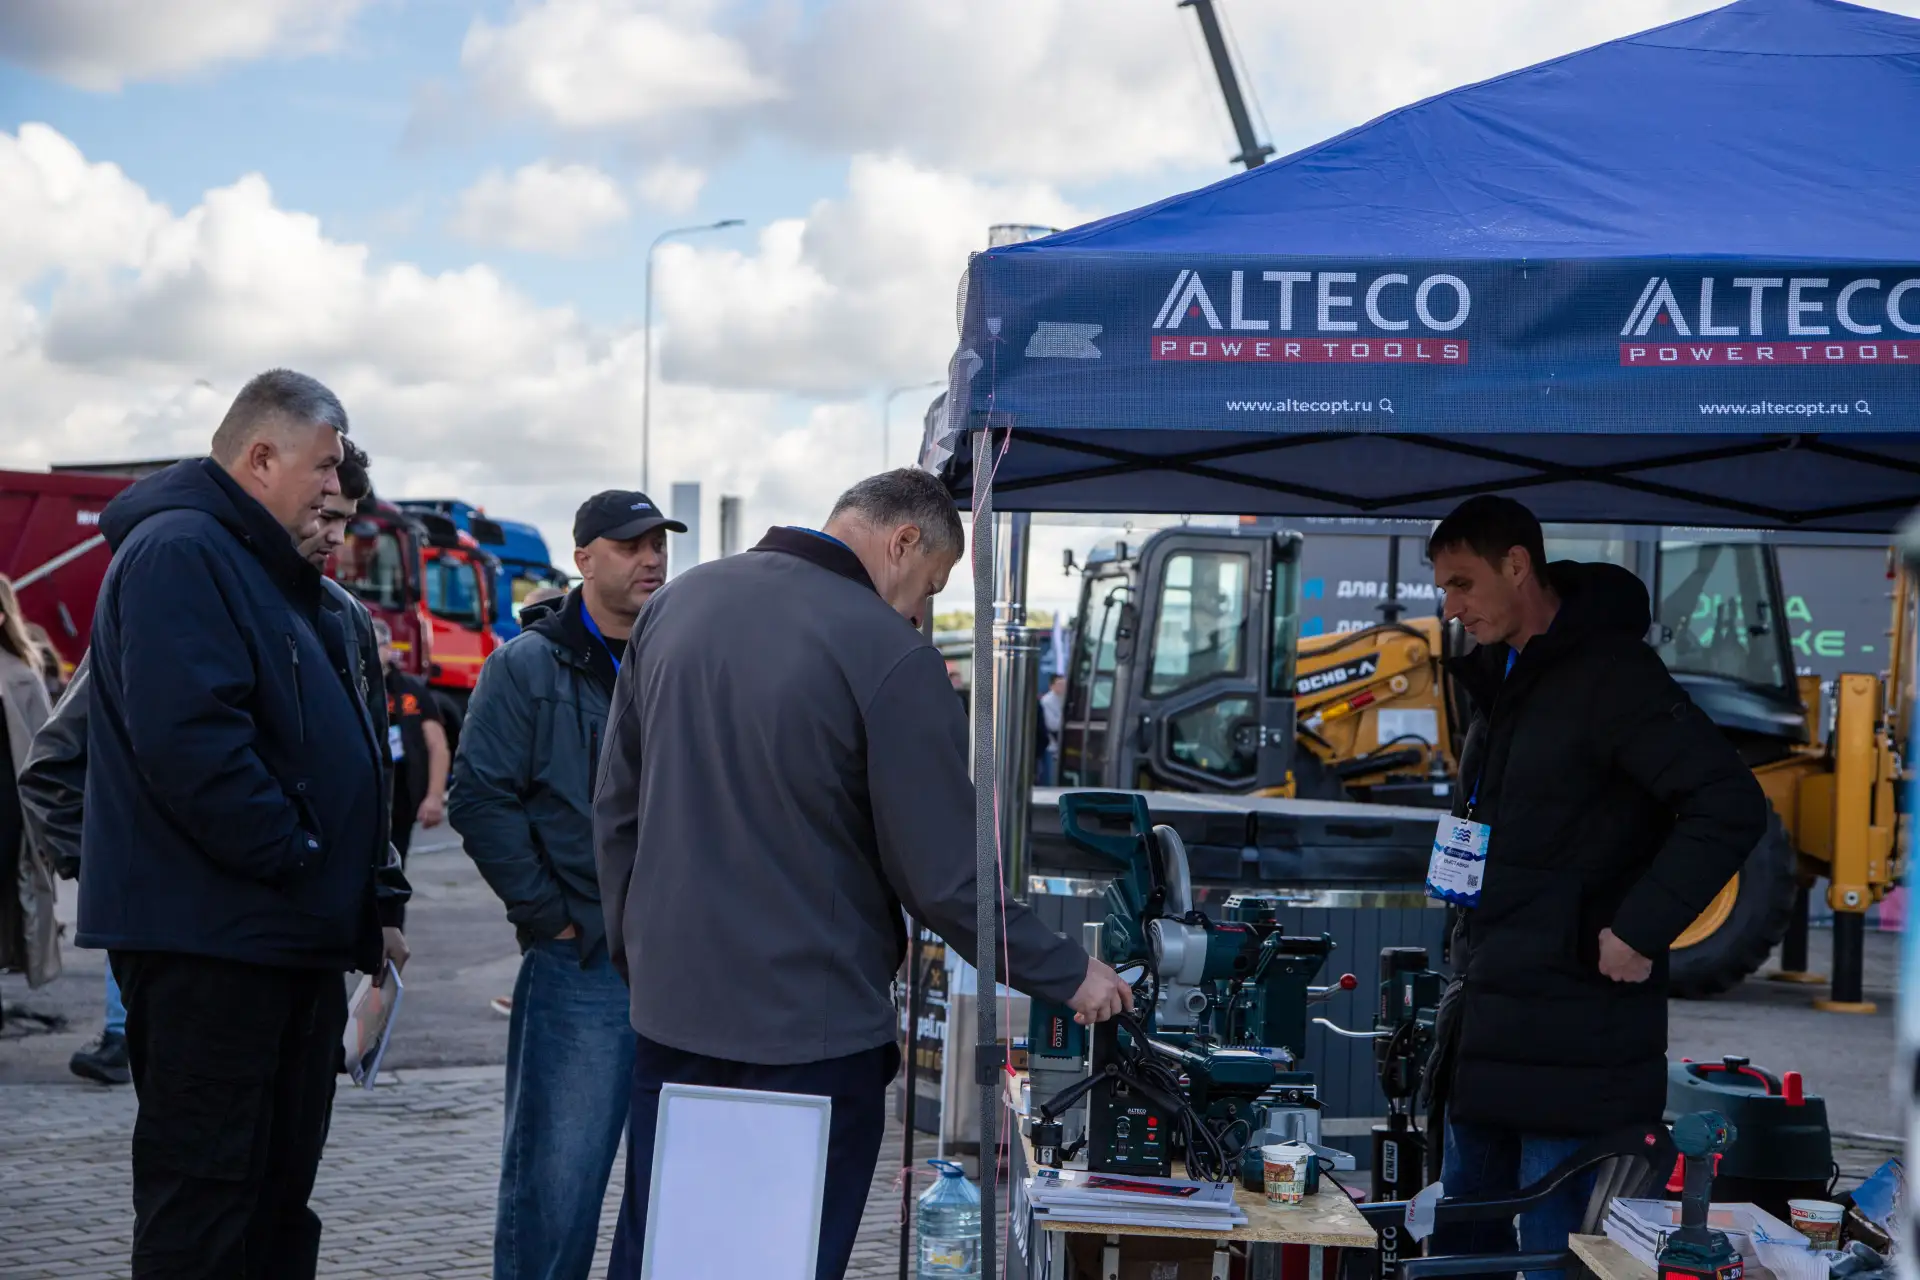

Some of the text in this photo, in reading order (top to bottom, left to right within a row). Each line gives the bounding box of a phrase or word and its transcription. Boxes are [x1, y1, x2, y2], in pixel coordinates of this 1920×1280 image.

[1152, 269, 1471, 332] ALTECO
[1161, 340, 1460, 360] POWER TOOLS
[1629, 344, 1909, 361] POWER TOOL
[1226, 398, 1373, 416] www.altecopt.ru
[1699, 399, 1849, 417] www.altecopt.ru
[1337, 581, 1377, 598] ДЛЯ
[1382, 1226, 1398, 1280] TECO
